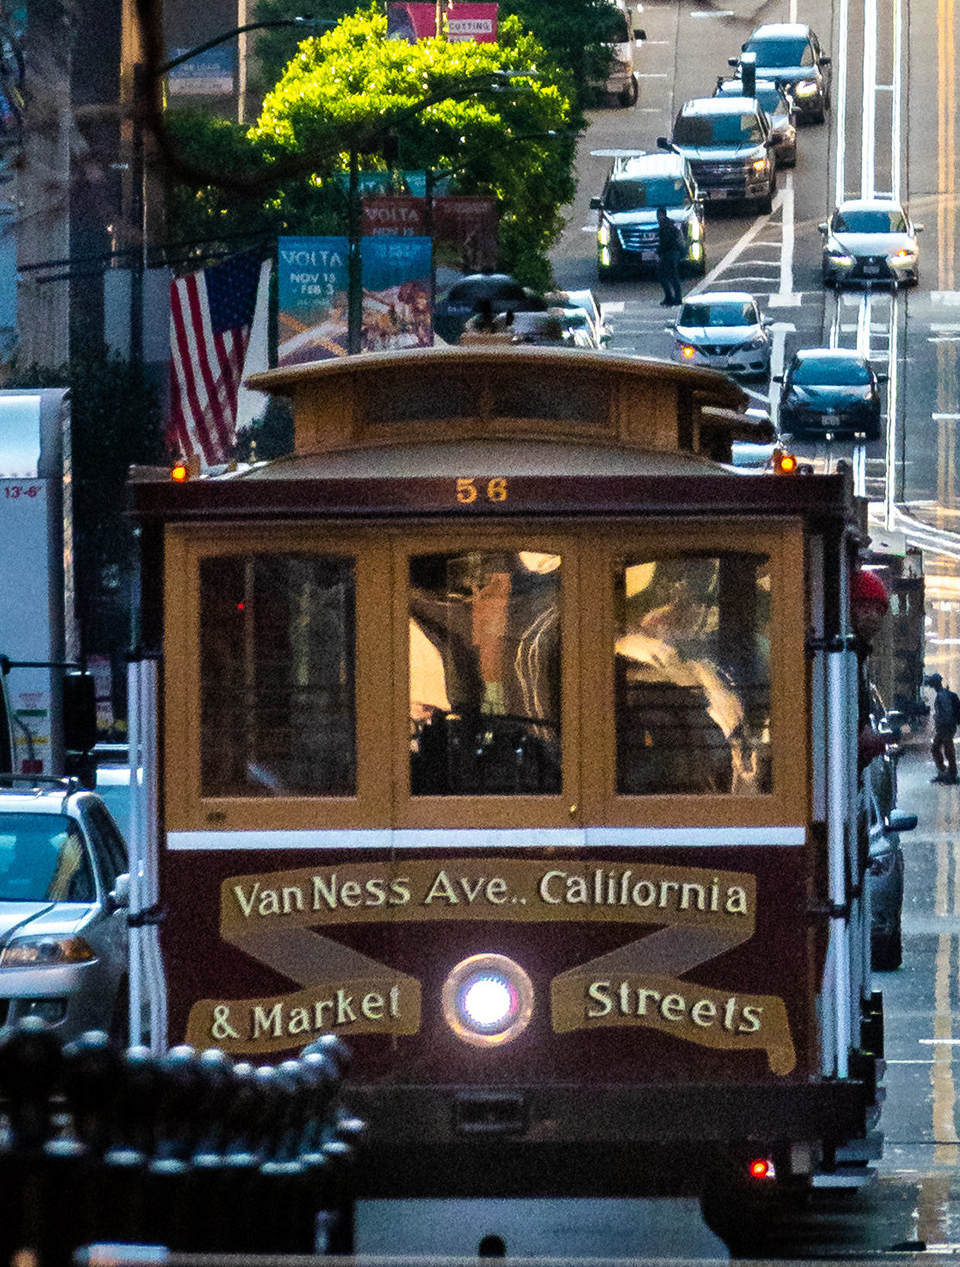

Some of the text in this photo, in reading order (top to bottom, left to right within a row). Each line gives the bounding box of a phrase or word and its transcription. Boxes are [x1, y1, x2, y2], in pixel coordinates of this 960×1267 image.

[449, 21, 490, 32] CUTTING
[364, 207, 420, 222] VOLTA
[280, 250, 343, 268] VOLTA
[290, 272, 320, 283] NOV
[456, 477, 508, 503] 56
[233, 882, 304, 917] Van
[311, 871, 411, 911] Ness
[539, 869, 749, 915] California
[210, 983, 401, 1039] & Market
[586, 980, 764, 1033] Streets
